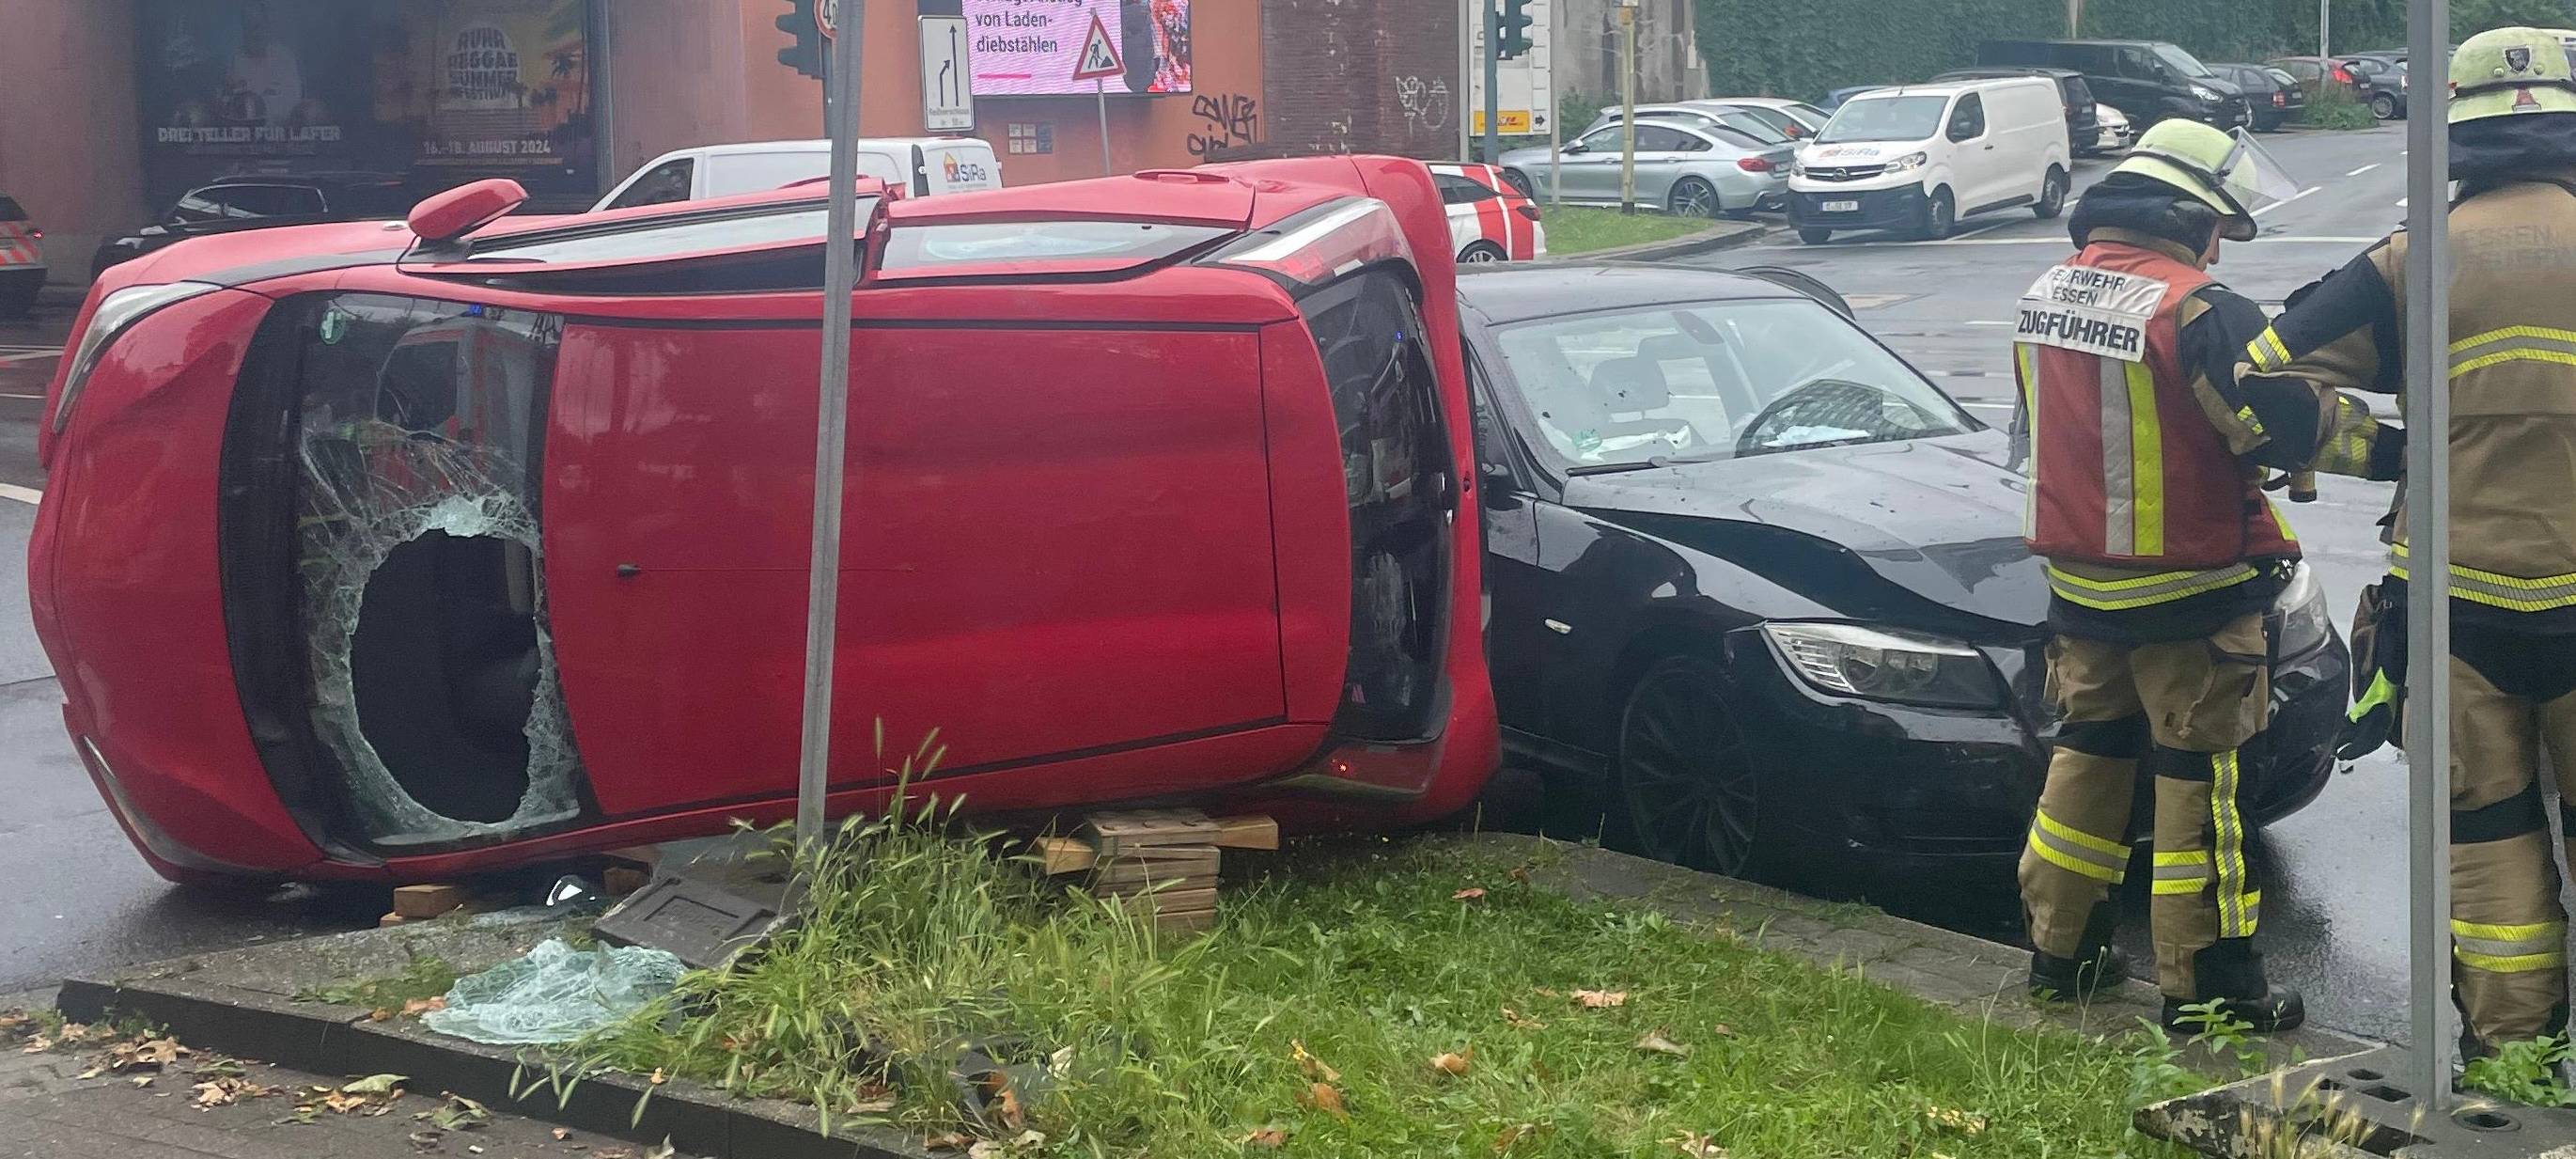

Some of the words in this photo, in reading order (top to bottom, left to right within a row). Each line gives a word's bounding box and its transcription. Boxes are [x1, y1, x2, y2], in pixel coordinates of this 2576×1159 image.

[976, 14, 1001, 27] von
[1006, 10, 1053, 27] Laden-
[976, 36, 1058, 54] diebstählen
[194, 127, 251, 142] TELLER
[469, 140, 517, 154] AUGUST
[521, 139, 552, 154] 2024
[960, 164, 987, 181] SiRa
[2052, 286, 2099, 306] ESSEN
[2017, 309, 2141, 353] ZUGFÜHRER
